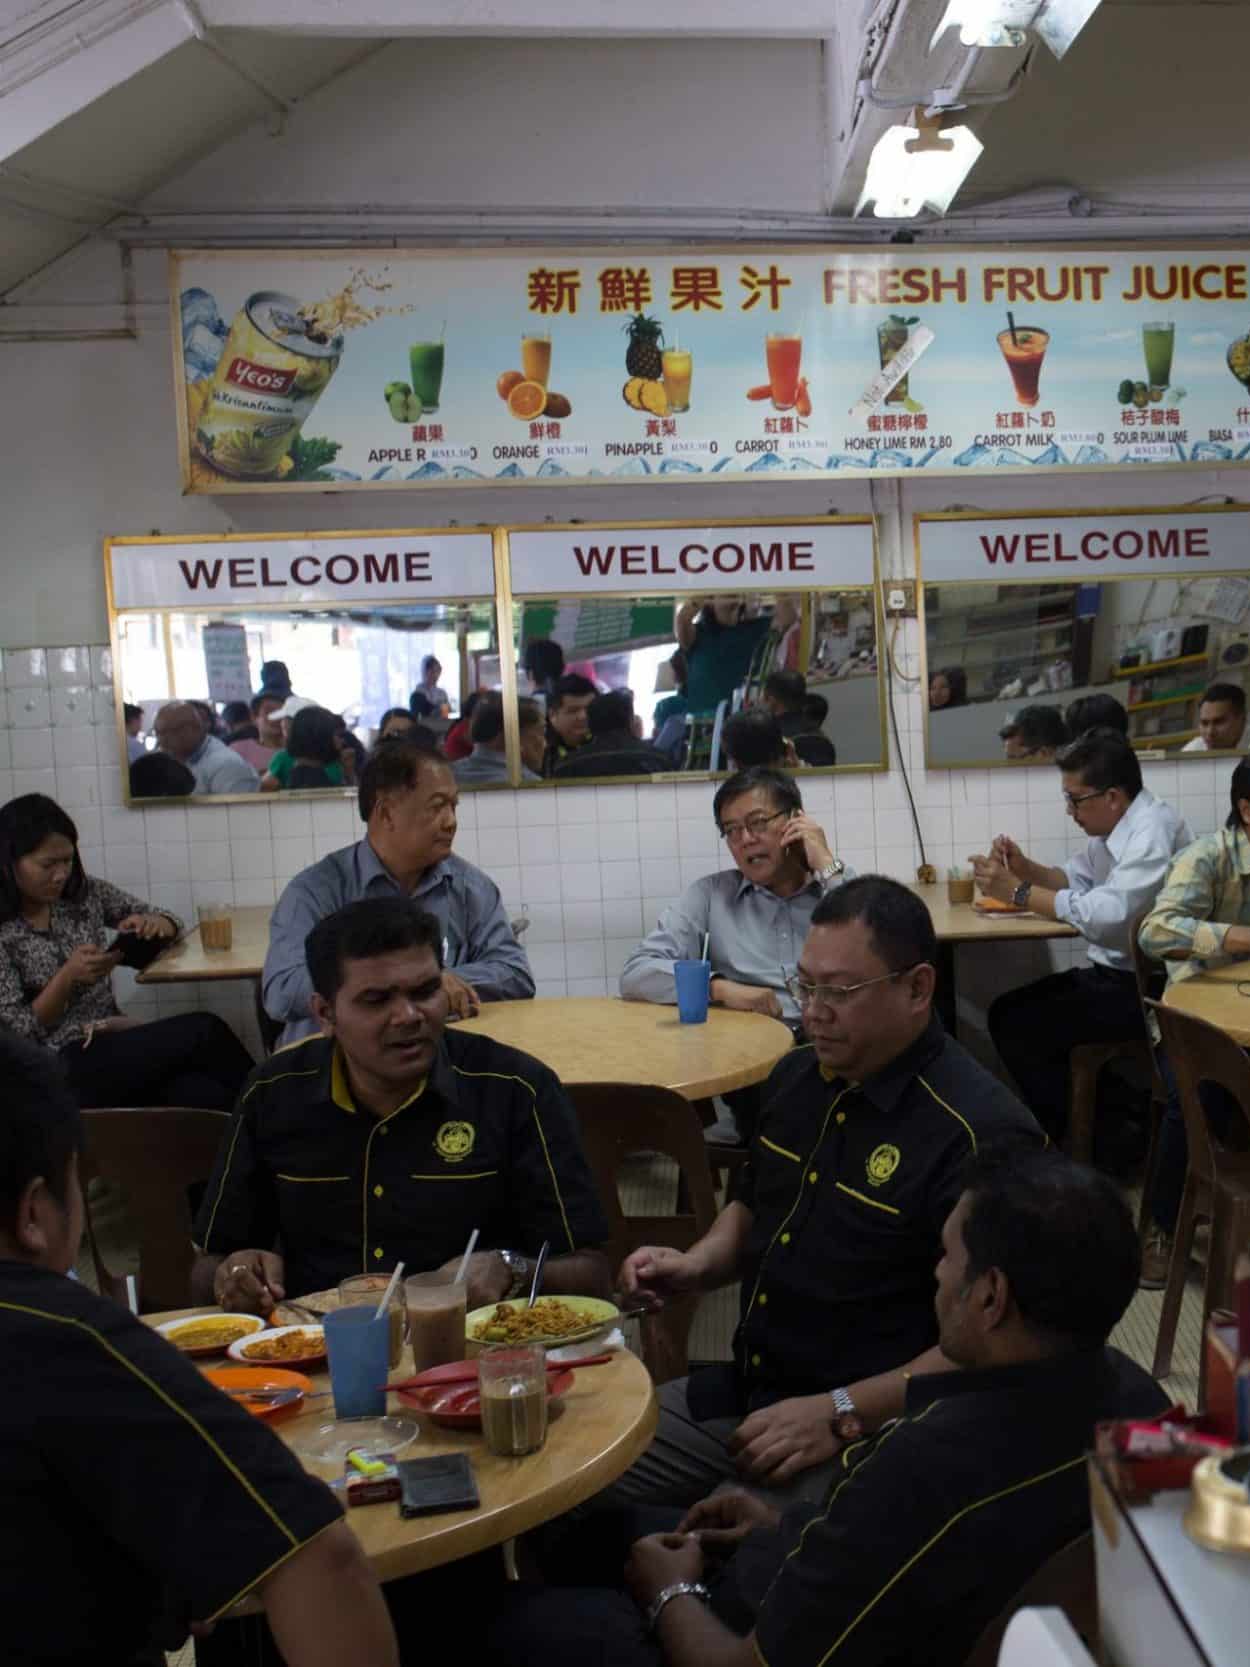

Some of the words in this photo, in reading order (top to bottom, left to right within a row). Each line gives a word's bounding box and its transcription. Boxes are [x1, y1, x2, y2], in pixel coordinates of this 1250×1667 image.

[527, 265, 792, 314] 新鮮果汁
[823, 265, 967, 305] FRESH
[983, 265, 1110, 304] FRUIT
[1121, 264, 1248, 301] JUICE
[974, 433, 1022, 448] CARROT
[1025, 433, 1054, 446] MILK
[1113, 431, 1139, 445] SOUR
[1140, 431, 1167, 444] PLUM
[1167, 430, 1188, 444] LIME
[1209, 428, 1233, 441] BIASA
[605, 441, 664, 457] PINAPPLE
[735, 439, 779, 454] CARROT
[844, 437, 881, 452] HONEY
[884, 436, 908, 450] LIME
[910, 435, 927, 449] RM
[368, 447, 411, 463] APPLE
[493, 445, 539, 459] ORANGE
[980, 528, 1210, 564] WELCOME
[574, 541, 815, 577] WELCOME
[179, 552, 432, 590] WELCOME
